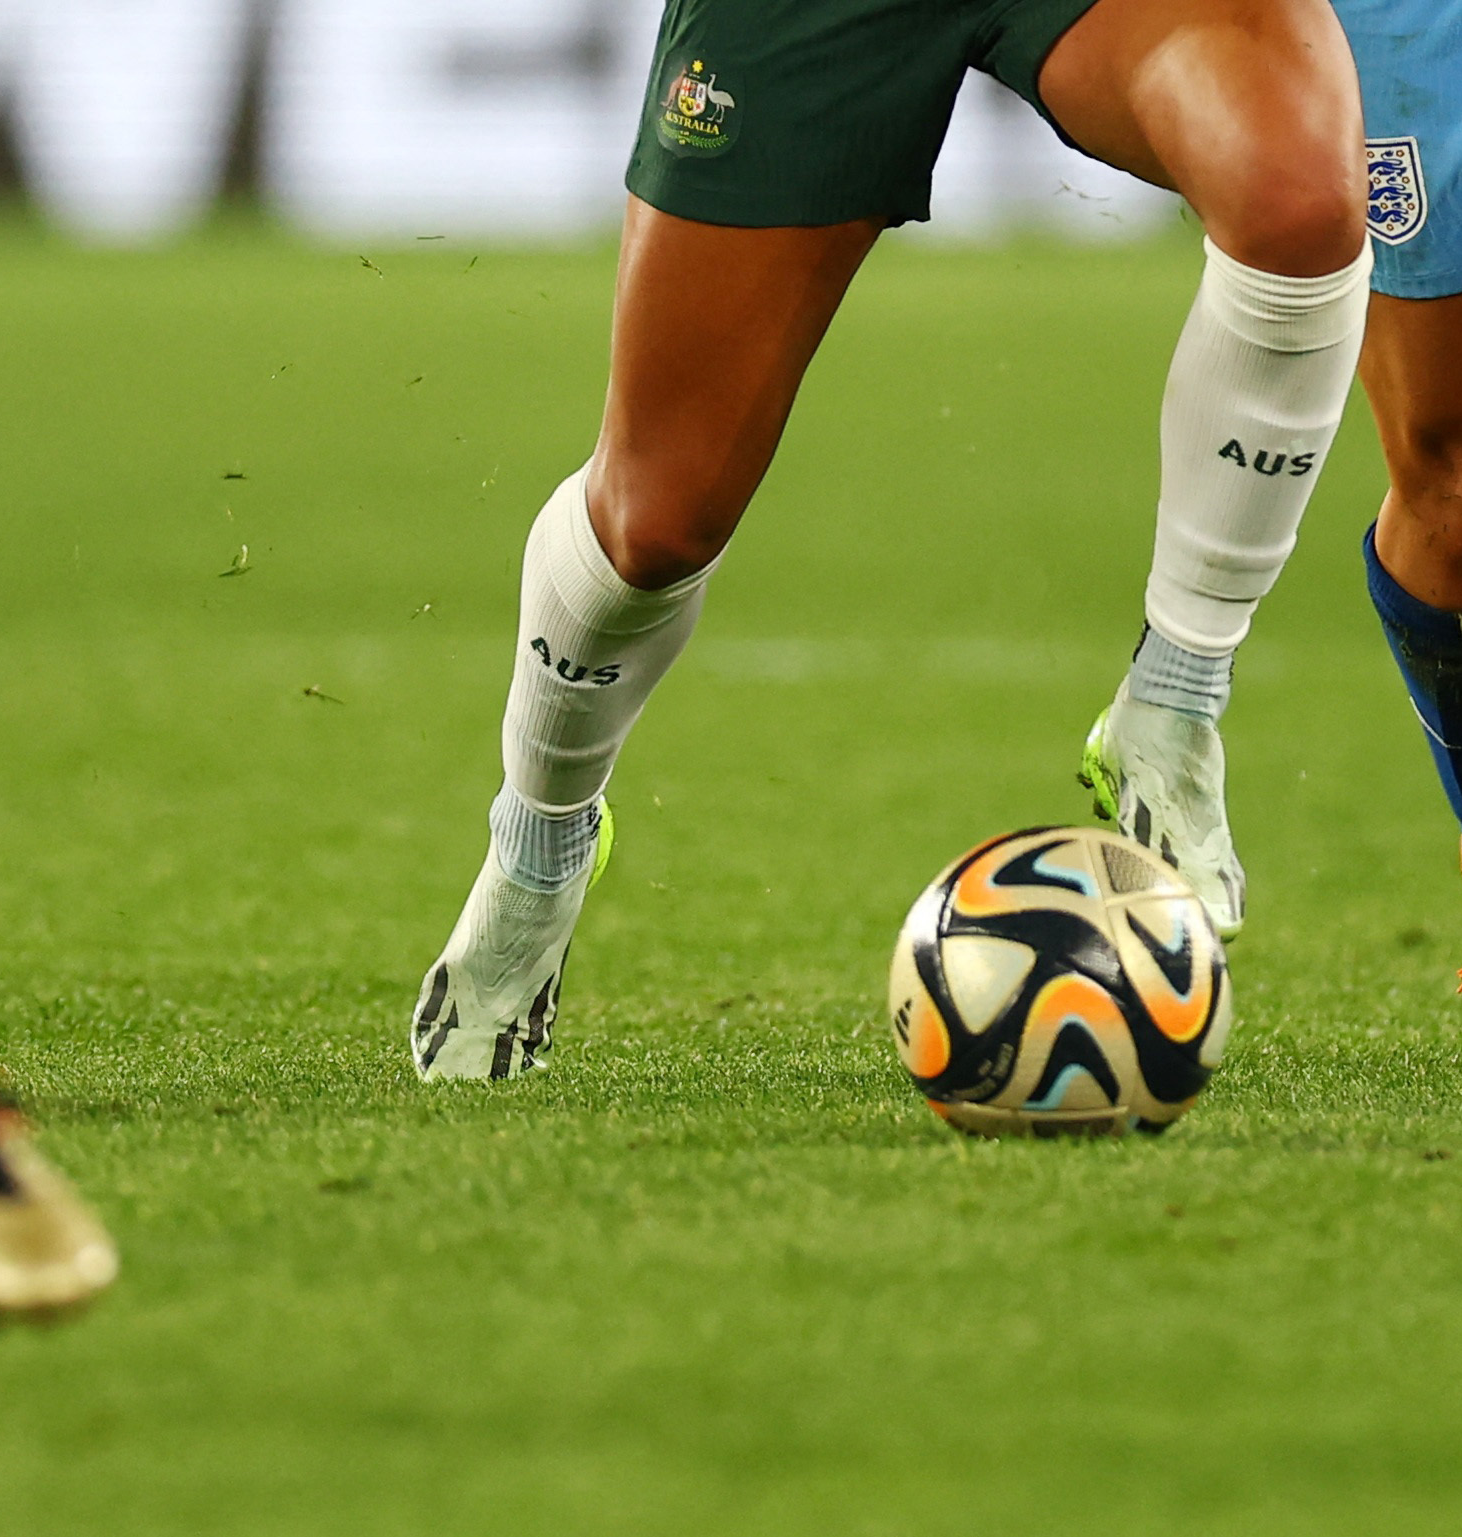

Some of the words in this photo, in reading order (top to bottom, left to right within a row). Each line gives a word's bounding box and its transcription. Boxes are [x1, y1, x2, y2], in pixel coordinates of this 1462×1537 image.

[665, 110, 720, 135] AUSTRALIA
[1218, 438, 1316, 476] AUS
[530, 636, 623, 686] AUS
